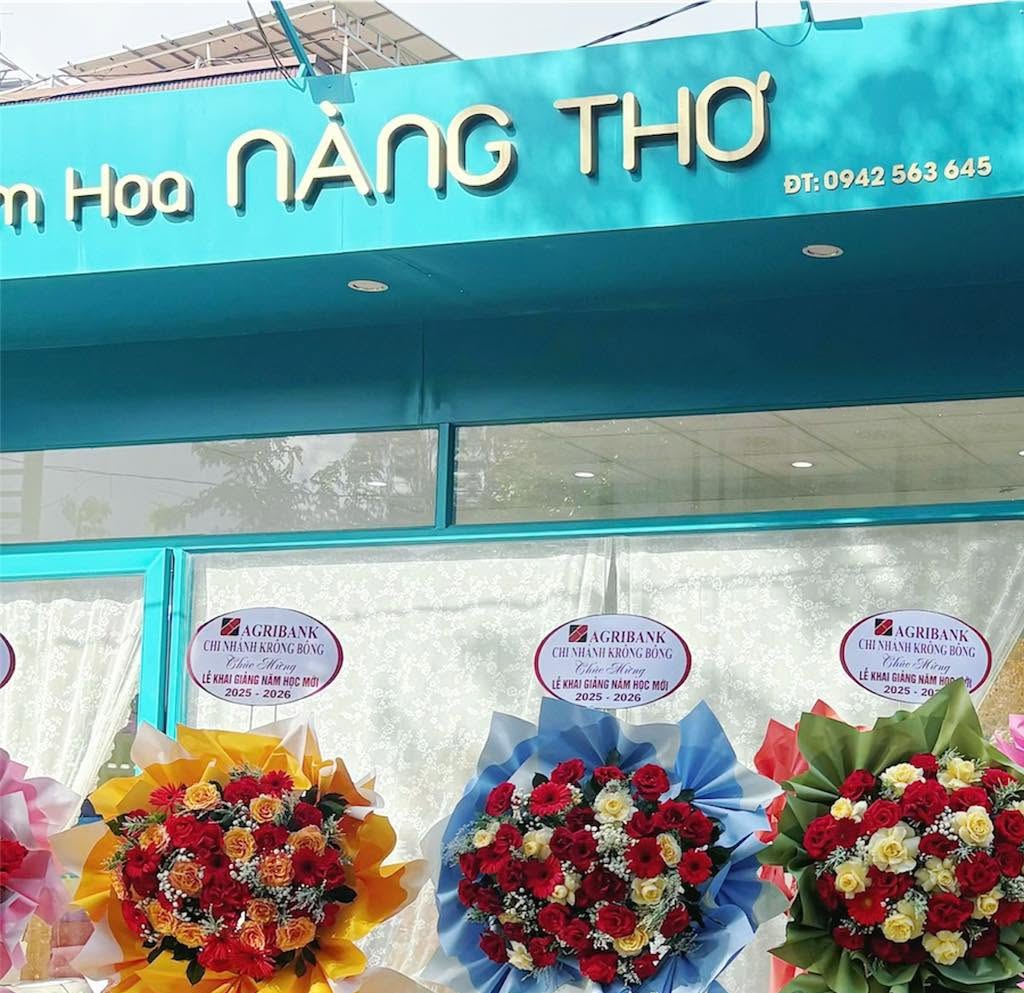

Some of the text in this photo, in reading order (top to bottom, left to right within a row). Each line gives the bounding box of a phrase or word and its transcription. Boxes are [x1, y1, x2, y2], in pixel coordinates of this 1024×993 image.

[65, 163, 190, 222] Hoa
[226, 100, 513, 208] NÀNG
[553, 70, 773, 176] THƠ
[891, 161, 938, 185] 563
[943, 155, 993, 181] 645
[241, 624, 319, 639] AGRIBANK
[589, 631, 666, 643] AGRIBANK
[895, 625, 969, 642] AGRIBANK
[203, 640, 220, 652] CHI
[223, 637, 257, 654] NHÁNH
[259, 638, 296, 655] KRÔNG
[552, 646, 568, 658] CHI
[571, 644, 605, 658] NHÁNH
[608, 644, 643, 659] KRÔNG
[858, 638, 875, 650] CHI
[878, 638, 912, 653] NHÁNH
[913, 640, 947, 656] KRÔNG
[226, 655, 255, 670] Chúc
[575, 661, 604, 675] Chúc
[882, 653, 911, 668] Chúc
[213, 674, 232, 684] KHAI
[283, 676, 300, 689] HỌC
[870, 671, 890, 682] KHAI
[225, 688, 252, 697] 2025
[263, 689, 291, 699] 2026
[563, 679, 581, 689] KHAI
[633, 680, 649, 693] HỌC
[884, 685, 911, 695] 2025
[575, 692, 602, 701] 2025
[613, 693, 642, 702] 2026
